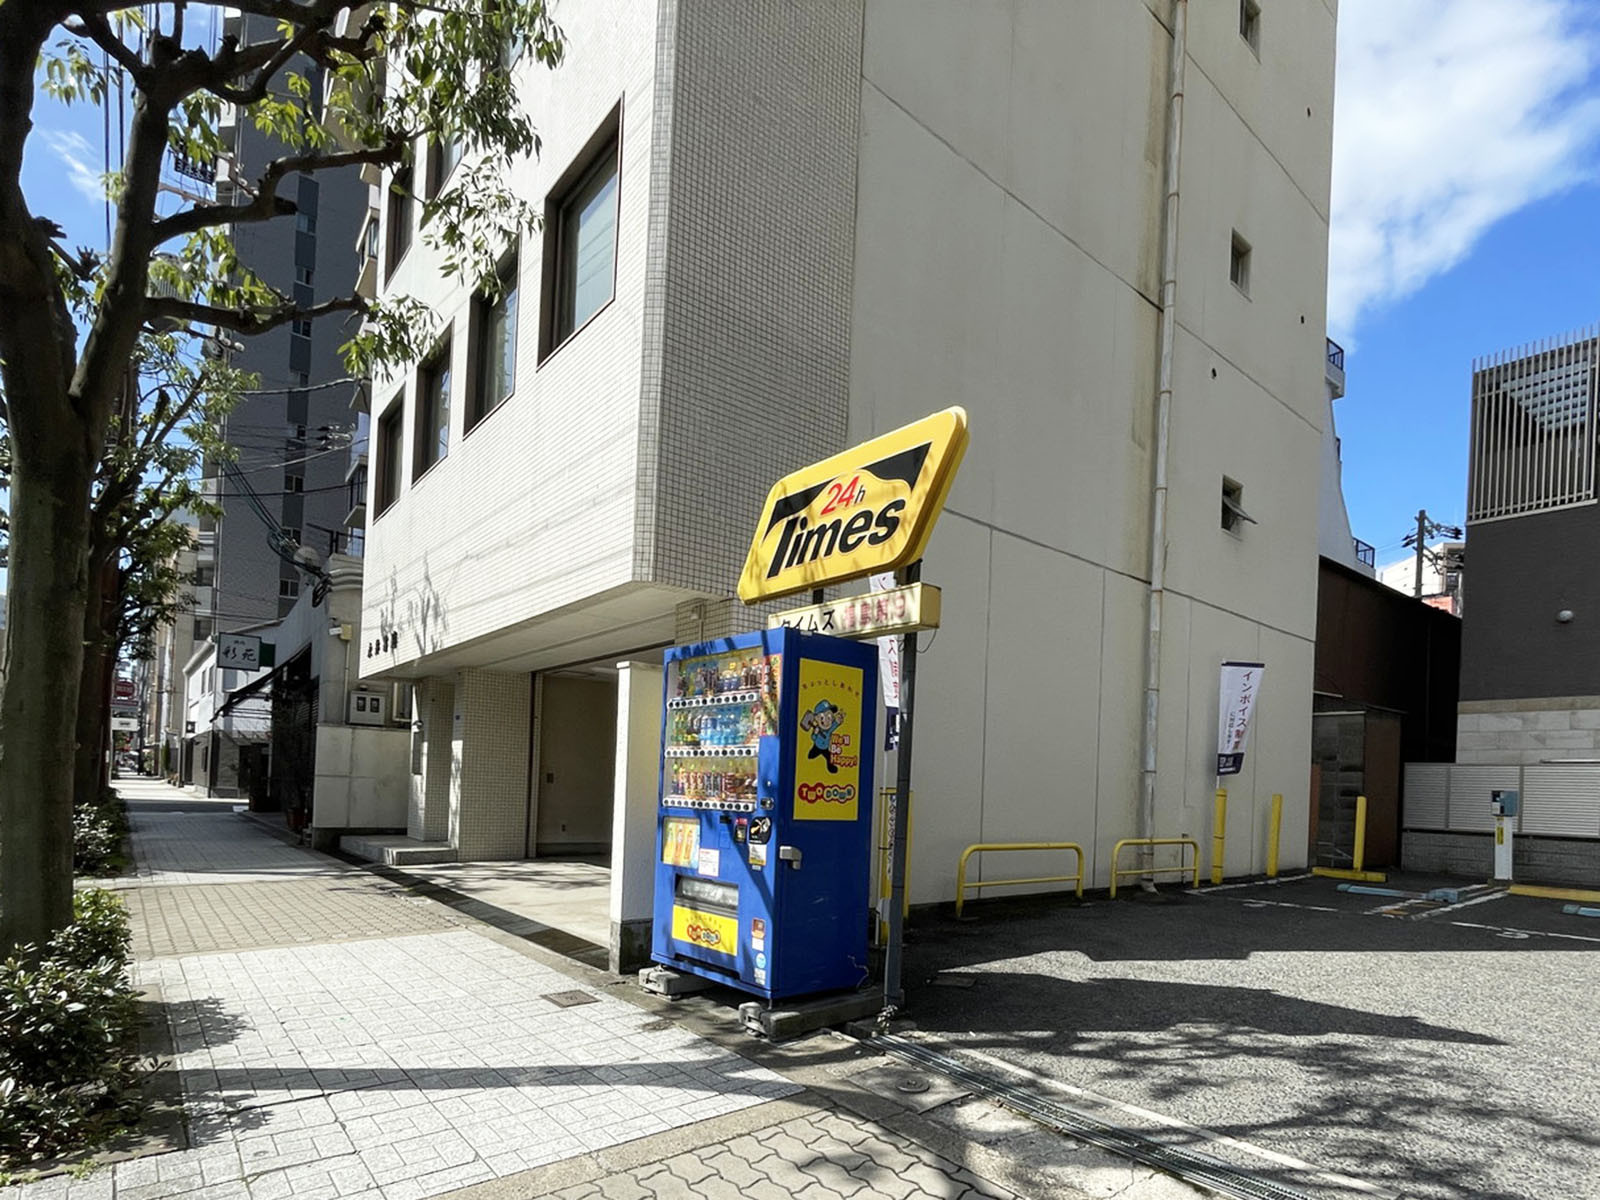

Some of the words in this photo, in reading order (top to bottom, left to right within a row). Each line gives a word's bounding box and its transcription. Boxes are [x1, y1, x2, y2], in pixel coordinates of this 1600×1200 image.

[820, 475, 866, 516] 24h
[766, 498, 906, 579] Times
[831, 744, 842, 754] Be
[825, 785, 854, 802] DOWN
